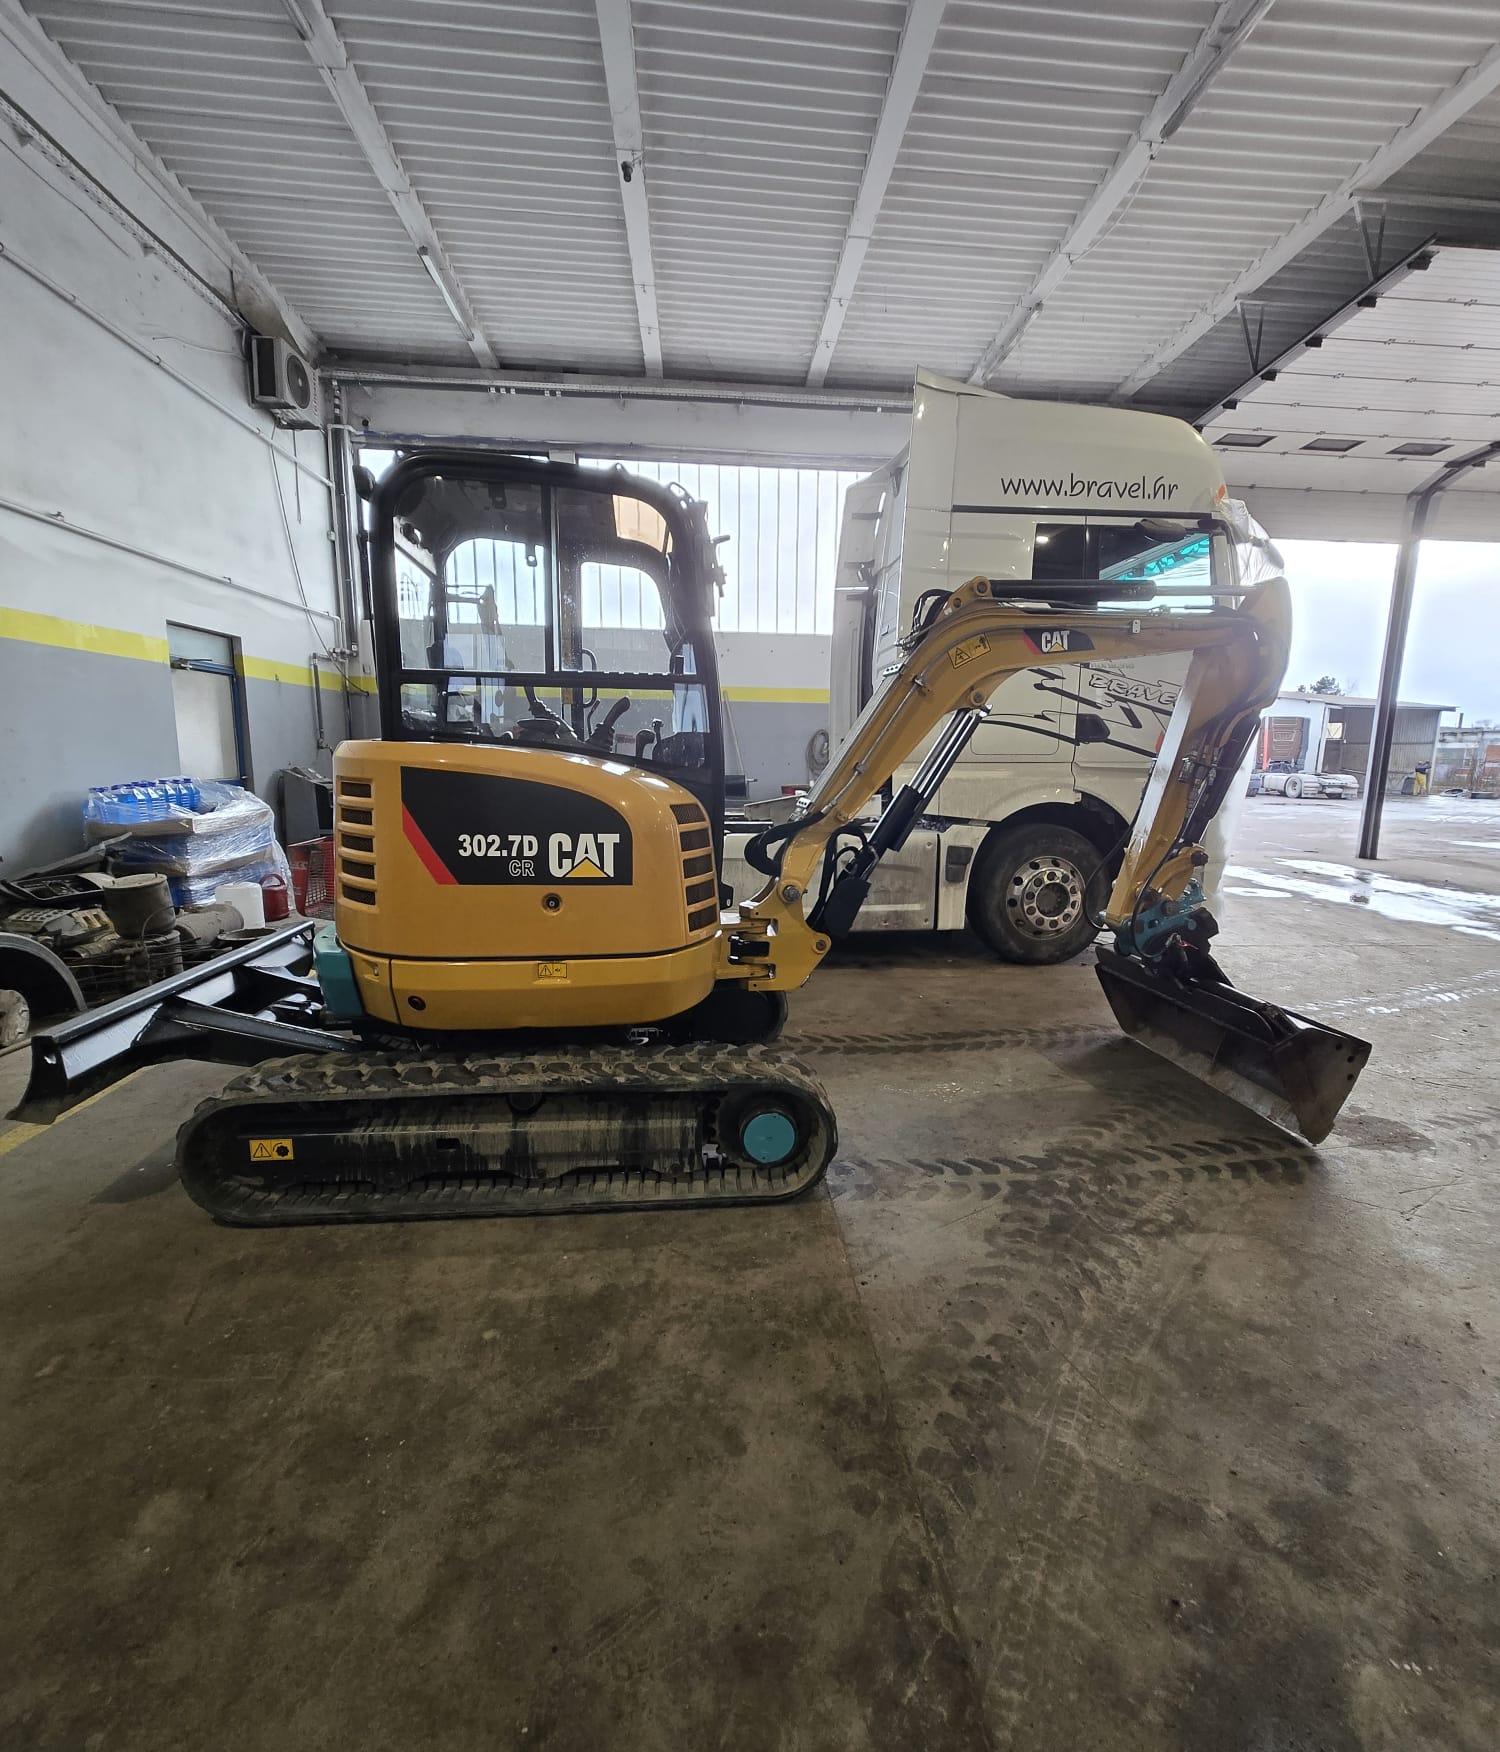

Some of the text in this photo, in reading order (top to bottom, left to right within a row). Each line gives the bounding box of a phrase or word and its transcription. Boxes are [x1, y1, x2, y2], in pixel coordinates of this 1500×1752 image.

[1000, 472, 1179, 500] www.bravel.hr
[1041, 630, 1070, 653] CAT
[1089, 673, 1180, 706] BRAVE
[457, 833, 539, 857] 302.7D
[548, 832, 620, 878] CAT
[508, 859, 535, 877] CR
